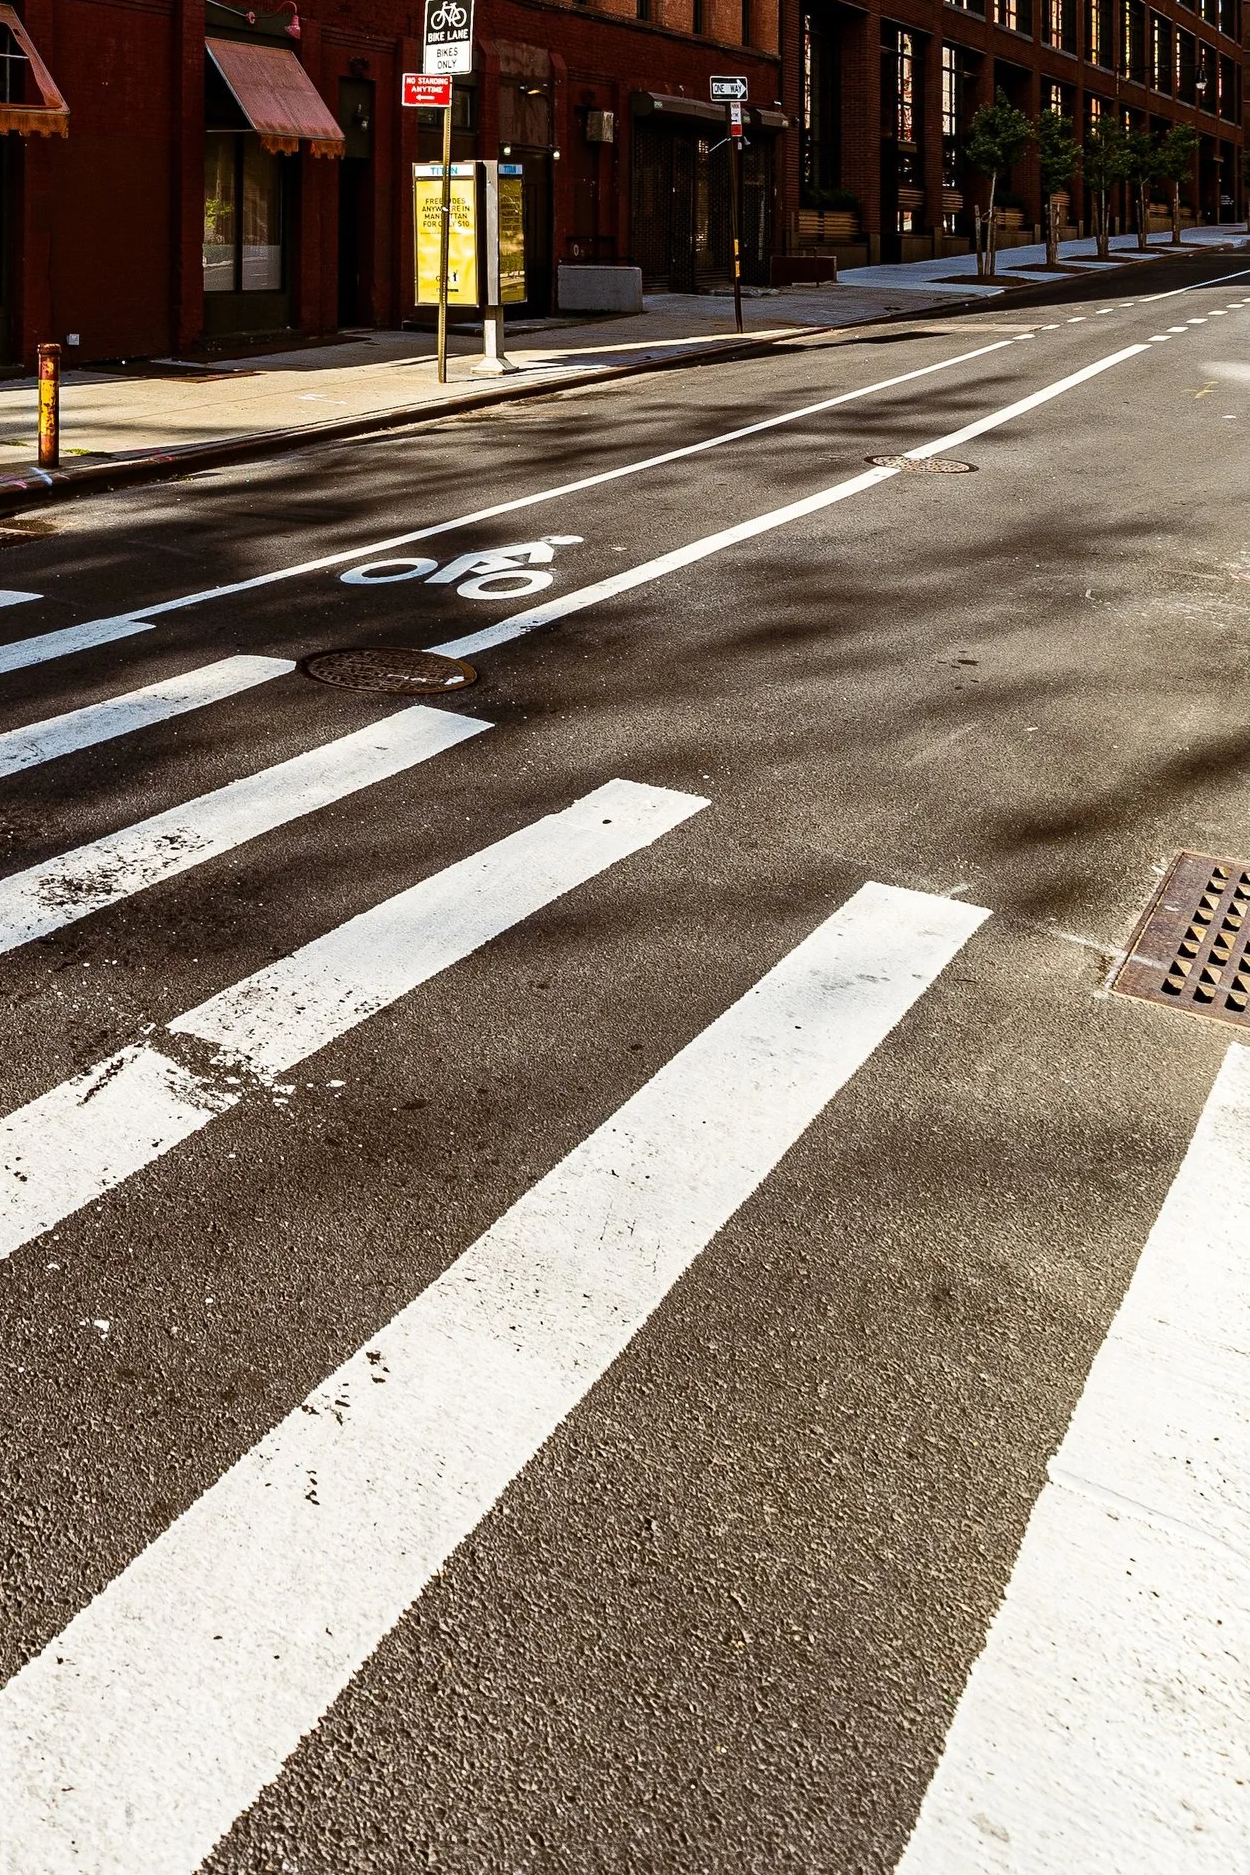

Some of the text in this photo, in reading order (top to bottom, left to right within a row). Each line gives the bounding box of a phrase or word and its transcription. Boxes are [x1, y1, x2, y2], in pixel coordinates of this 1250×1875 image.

[428, 28, 469, 43] BIKE LANE
[436, 46, 459, 58] BIKES
[437, 59, 457, 70] ONLY
[406, 76, 449, 85] NO STANDING
[411, 86, 444, 94] ANYTIME
[714, 84, 743, 93] ONE WAY
[430, 166, 458, 175] TITN
[423, 220, 437, 228] FOR
[457, 220, 470, 228] $10
